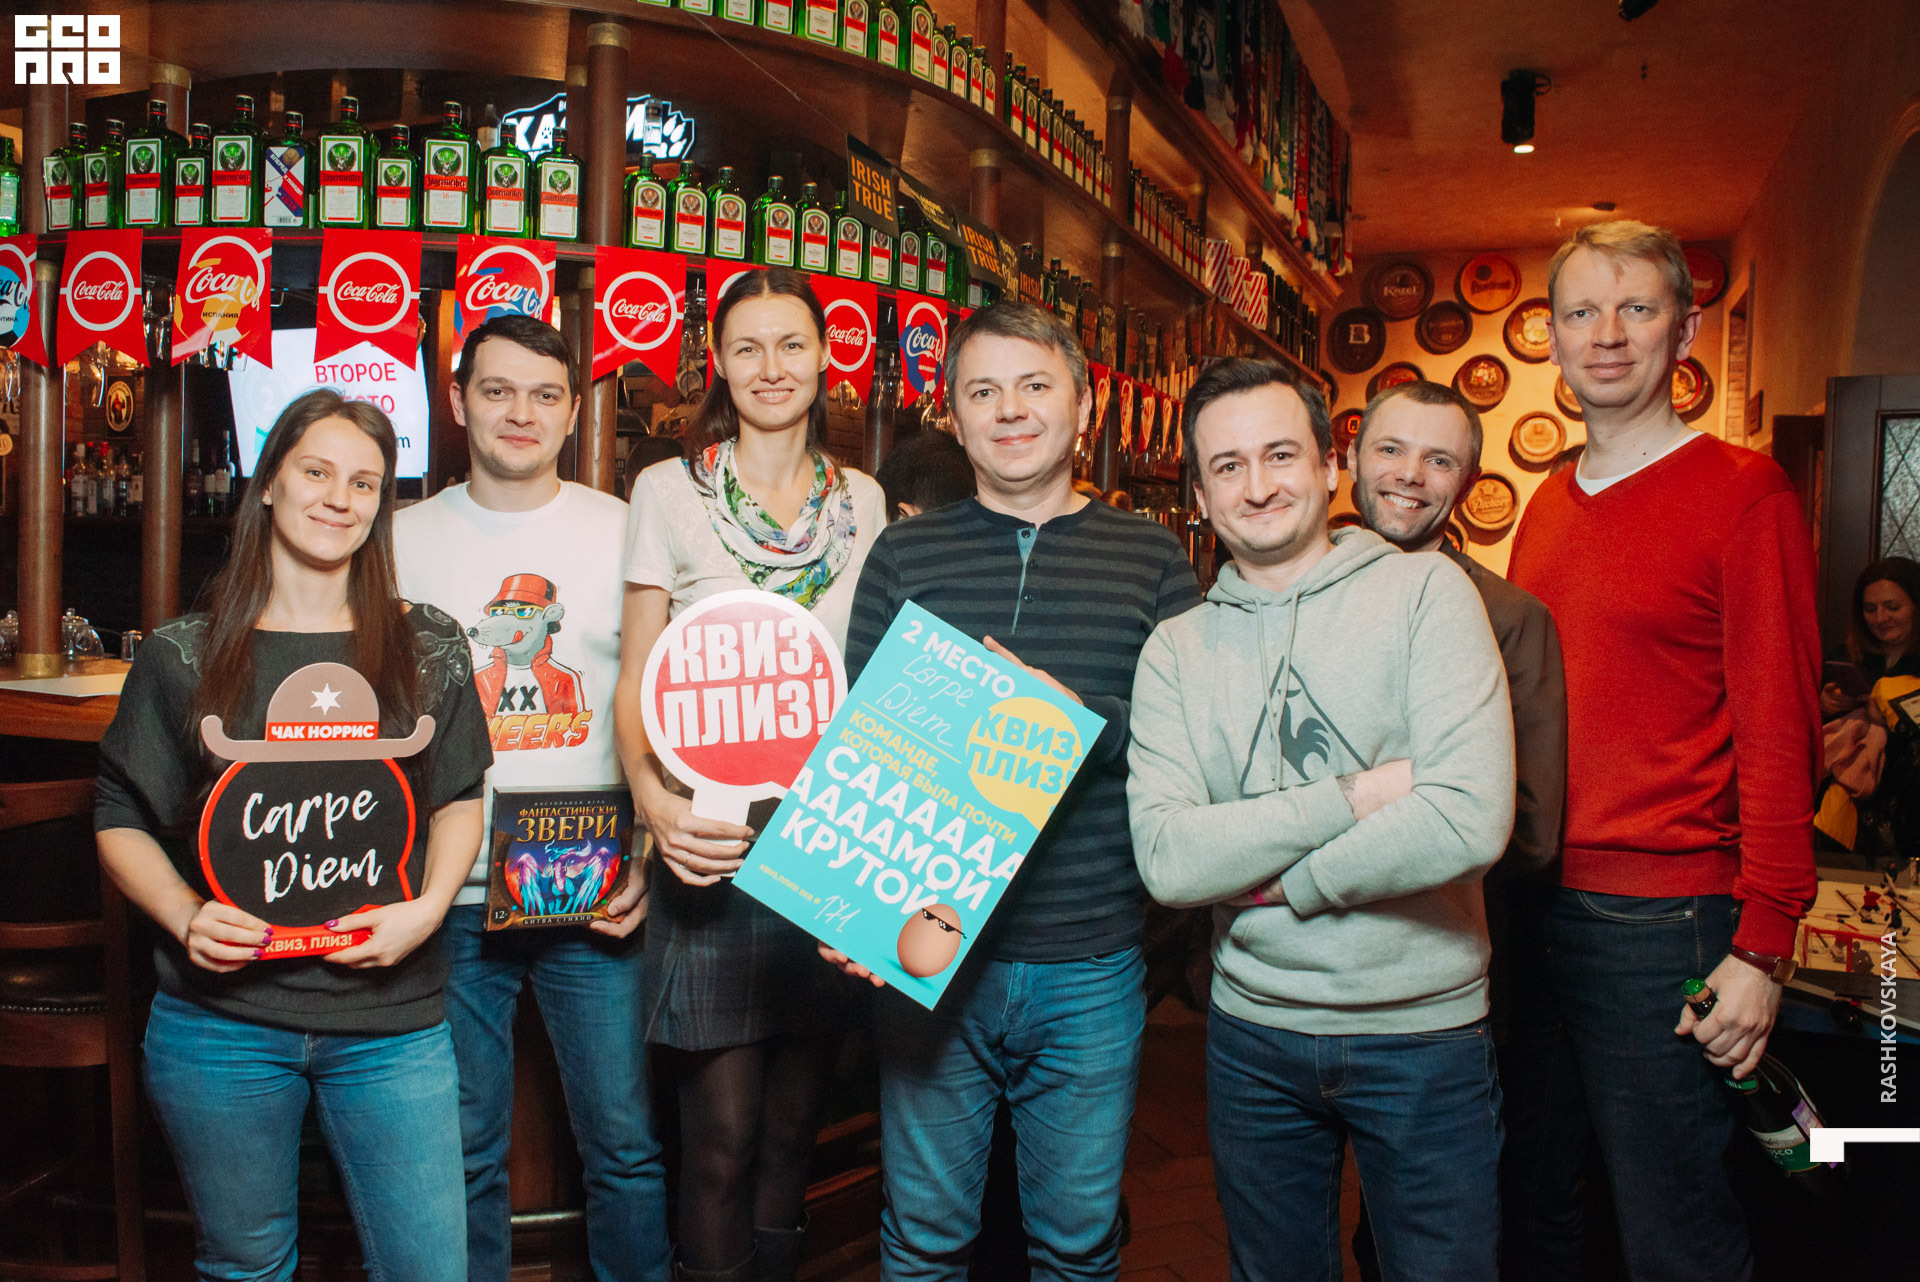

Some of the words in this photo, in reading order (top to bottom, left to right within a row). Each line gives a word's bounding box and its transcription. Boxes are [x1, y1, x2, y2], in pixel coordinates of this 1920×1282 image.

[851, 156, 892, 198] IRISH
[853, 180, 894, 221] TRUE
[962, 224, 997, 256] IRISH
[967, 245, 1003, 278] TRUE
[74, 280, 126, 301] Coca-Cola
[337, 280, 401, 304] Coca-Cola
[202, 311, 239, 319] ИСПАНИЯ
[612, 298, 669, 323] Coca-Cola
[827, 324, 866, 346] Coca-Cola
[315, 362, 397, 384] ВТОРОЕ
[668, 616, 823, 685] КВИЗ,
[902, 620, 923, 644] 2
[923, 632, 1015, 698] МЕСТО
[902, 654, 973, 707] Carpe
[271, 726, 305, 739] ЧАК
[308, 725, 375, 739] НОРРИС
[662, 678, 831, 749] ПЛИЗ!
[875, 682, 953, 747] Diem
[849, 710, 939, 777] КОМАНДЕ,
[839, 728, 913, 780] КОТОРАЯ
[912, 773, 960, 811] БЫЛА
[960, 802, 1017, 845] ПОЧТИ
[242, 790, 379, 843] Carpe
[516, 814, 618, 843] ЗВЕРИ
[519, 805, 619, 818] ФАНТАСТИЧЕСКИЕ
[263, 849, 383, 903] Diem
[779, 808, 940, 915] КРУТОЙ
[814, 895, 861, 933] 171
[265, 938, 306, 953] КВИЗ,
[310, 934, 352, 949] ПЛИЗ!
